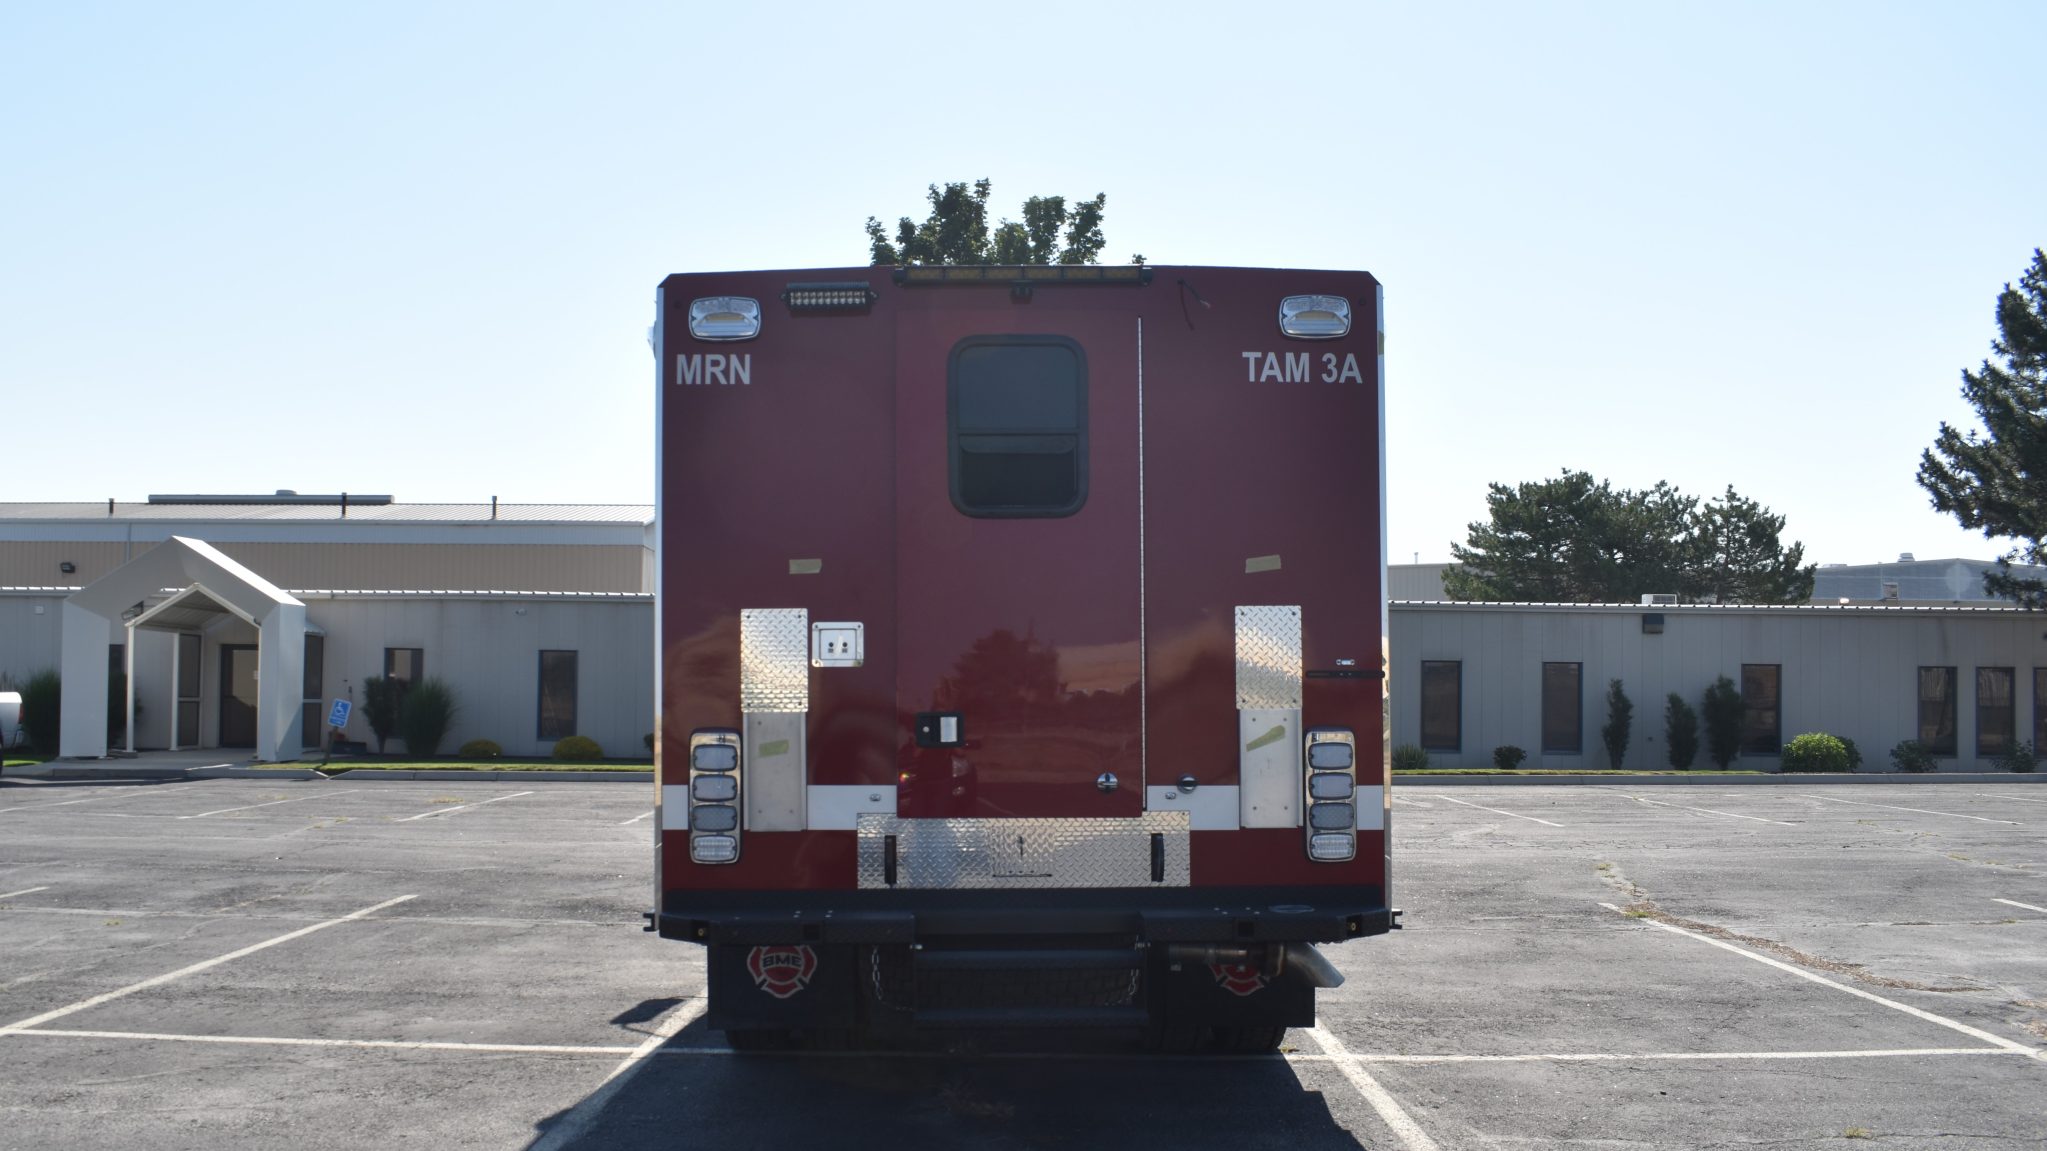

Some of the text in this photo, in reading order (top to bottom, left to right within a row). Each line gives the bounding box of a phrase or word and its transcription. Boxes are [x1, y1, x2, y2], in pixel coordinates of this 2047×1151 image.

[676, 354, 751, 385] MRN
[1242, 351, 1363, 384] TAM 3A
[762, 953, 802, 968] BME
